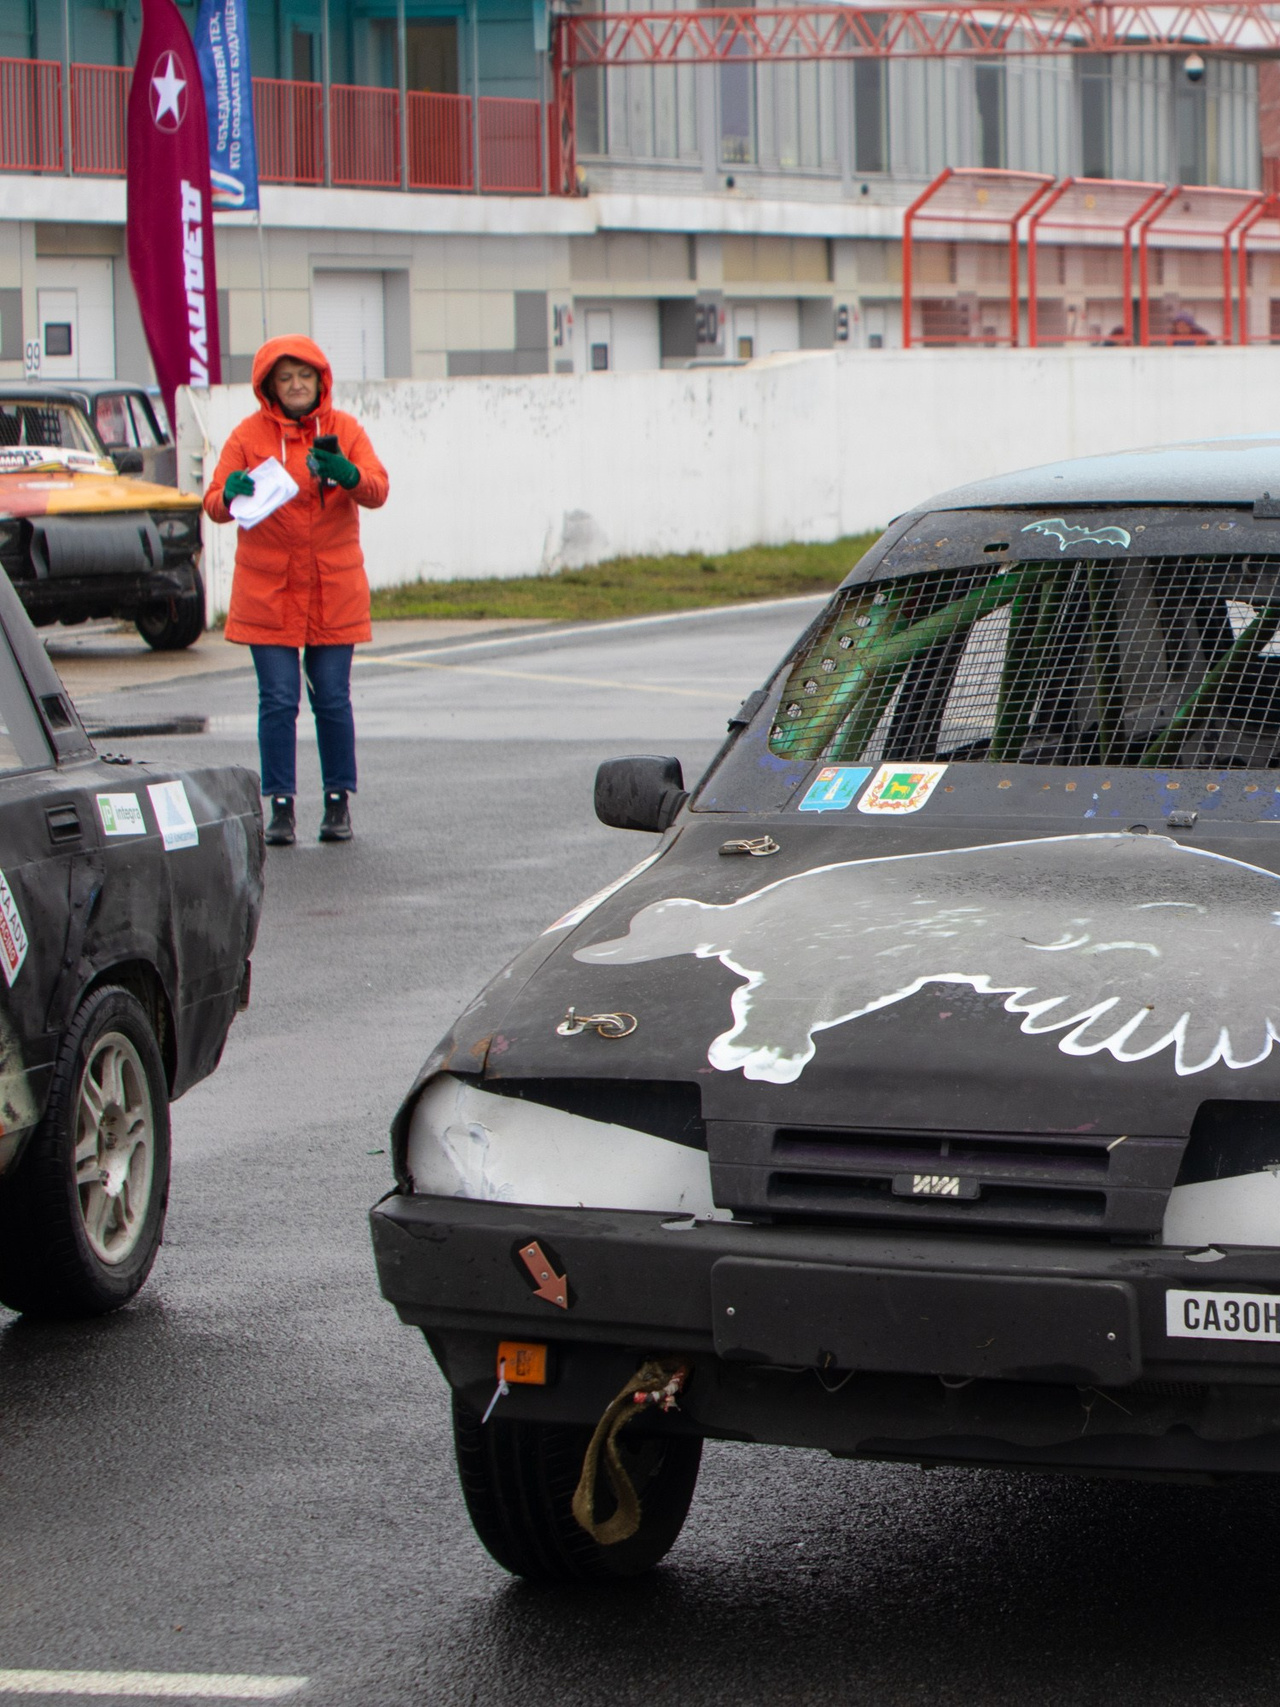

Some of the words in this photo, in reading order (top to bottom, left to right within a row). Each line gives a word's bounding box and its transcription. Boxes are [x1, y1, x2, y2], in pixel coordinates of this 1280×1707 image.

[212, 45, 230, 152] ОБЪЕДИНЯЕМ
[229, 141, 241, 170] КТО
[25, 342, 41, 371] 99
[114, 804, 142, 824] integra
